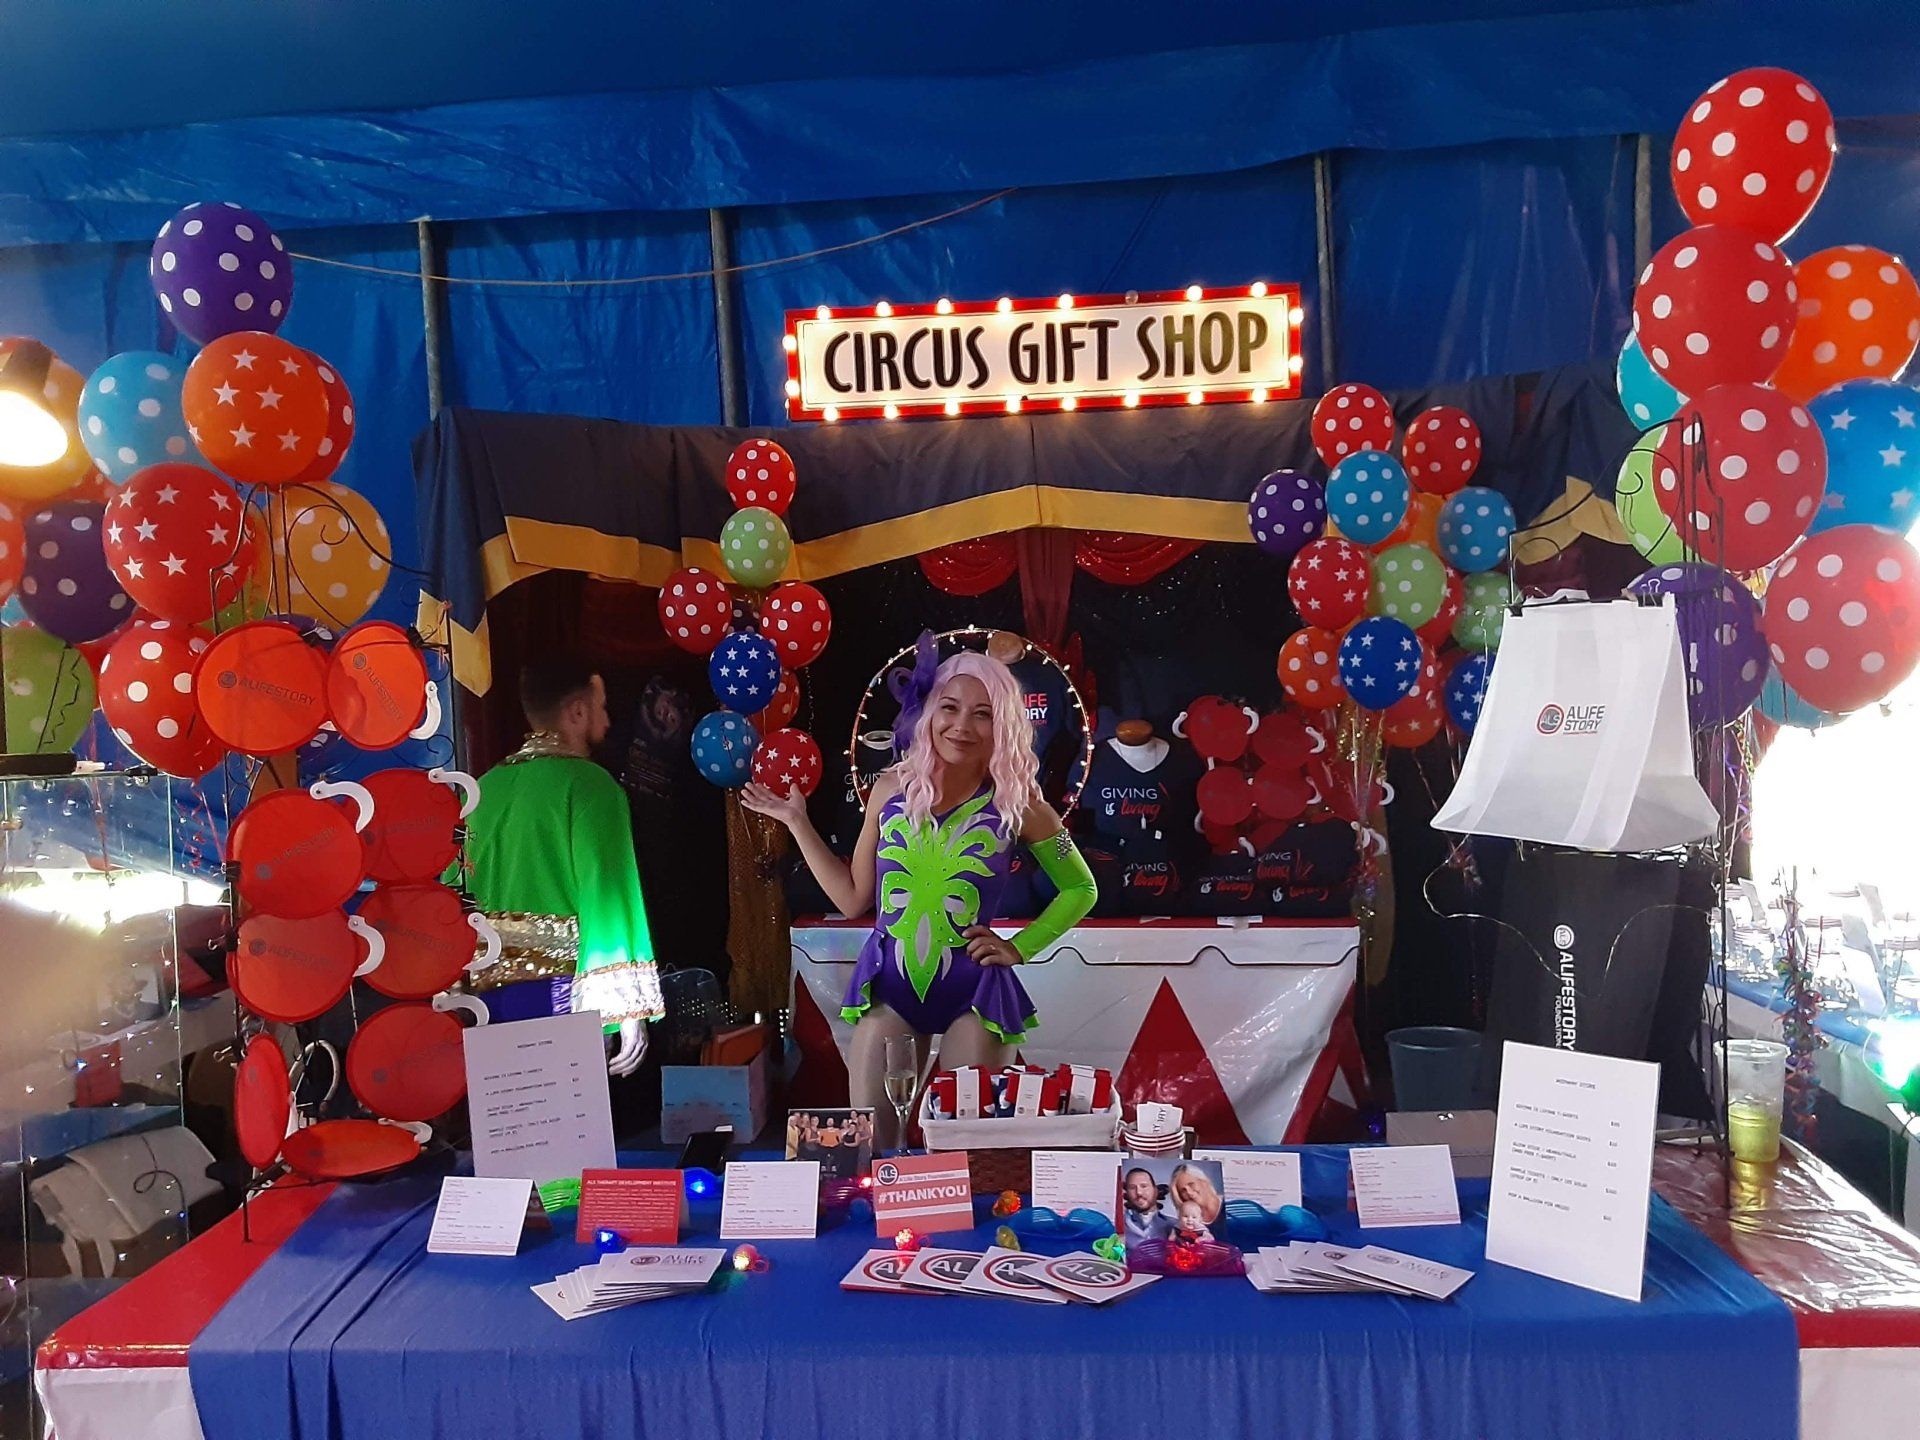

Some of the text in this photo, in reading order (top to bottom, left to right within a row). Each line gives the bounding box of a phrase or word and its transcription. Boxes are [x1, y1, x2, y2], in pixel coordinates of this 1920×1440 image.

[822, 311, 1268, 394] CIRCUS GIFT SHOP
[1563, 719, 1602, 731] STORY
[1101, 787, 1158, 800] GIVING
[878, 1184, 968, 1204] #THANKYOU
[1065, 1261, 1118, 1284] ALS
